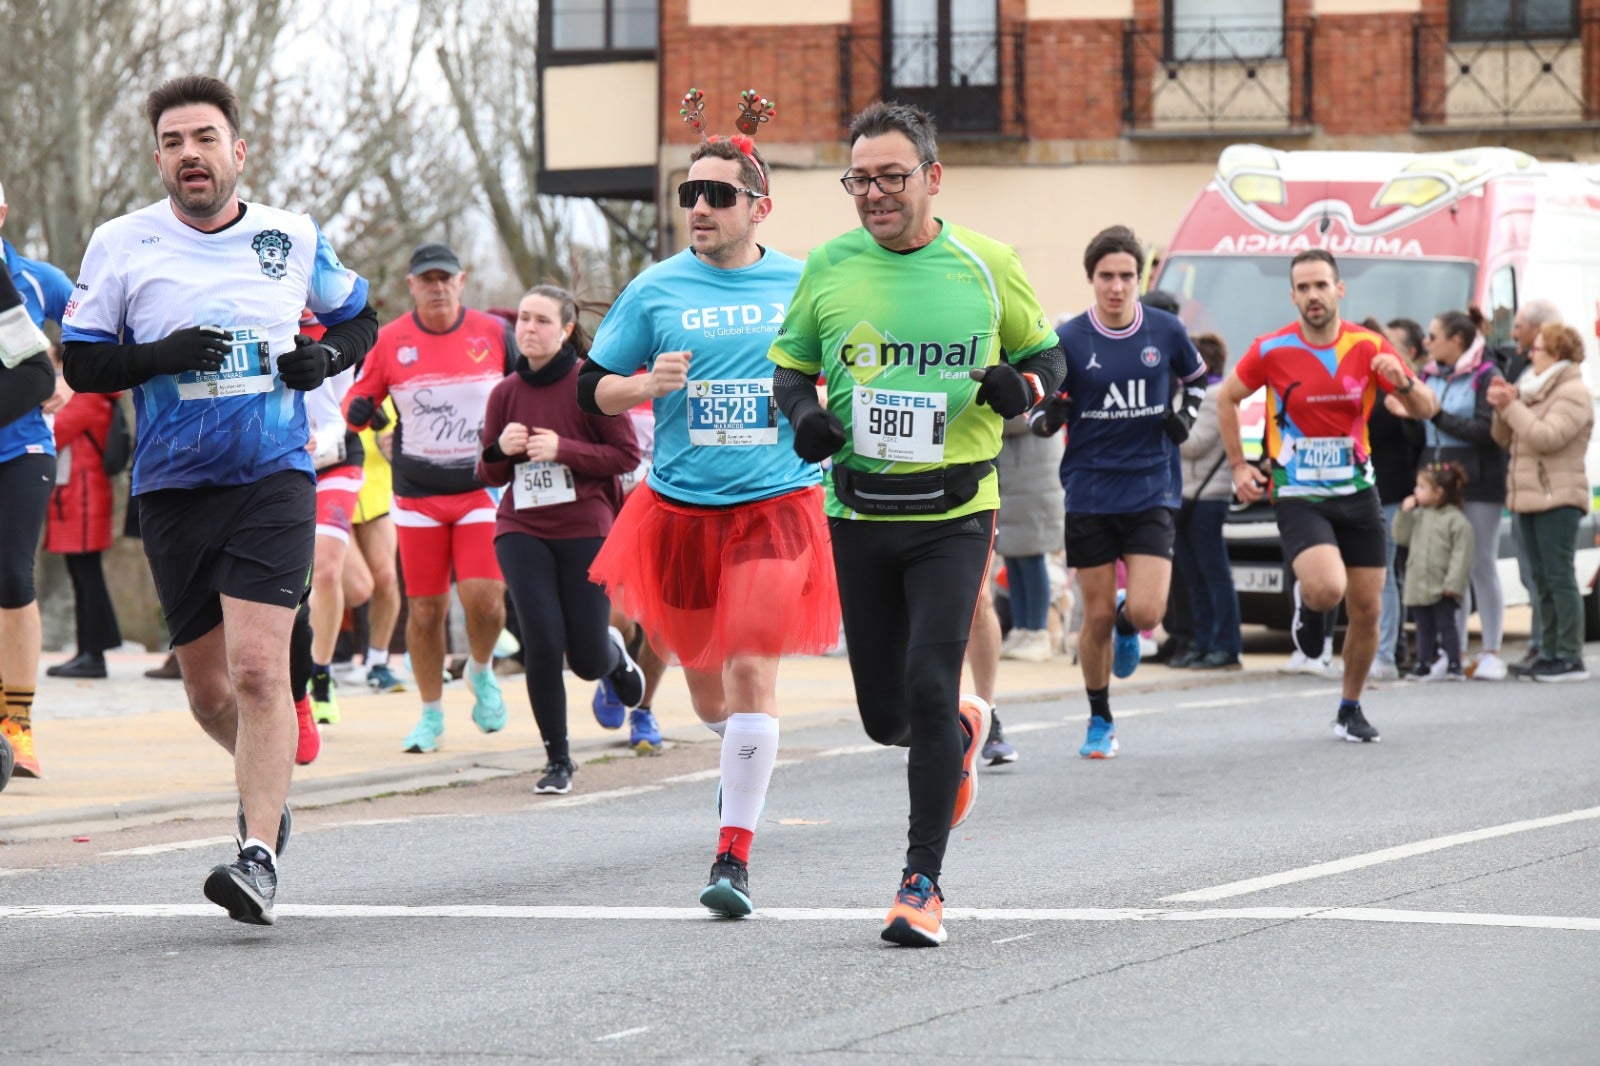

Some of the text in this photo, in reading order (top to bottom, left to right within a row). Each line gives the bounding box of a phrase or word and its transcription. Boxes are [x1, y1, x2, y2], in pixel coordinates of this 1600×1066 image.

[681, 304, 762, 330] GETD
[703, 328, 715, 339] by
[717, 326, 744, 336] Global
[840, 334, 979, 376] campal
[938, 369, 971, 380] Team
[711, 383, 770, 396] SETEL
[700, 397, 757, 424] 3528
[875, 393, 937, 409] SETEL
[869, 407, 914, 438] 980
[1110, 410, 1129, 419] LIVE
[1304, 448, 1340, 467] 4020
[524, 470, 553, 491] 546
